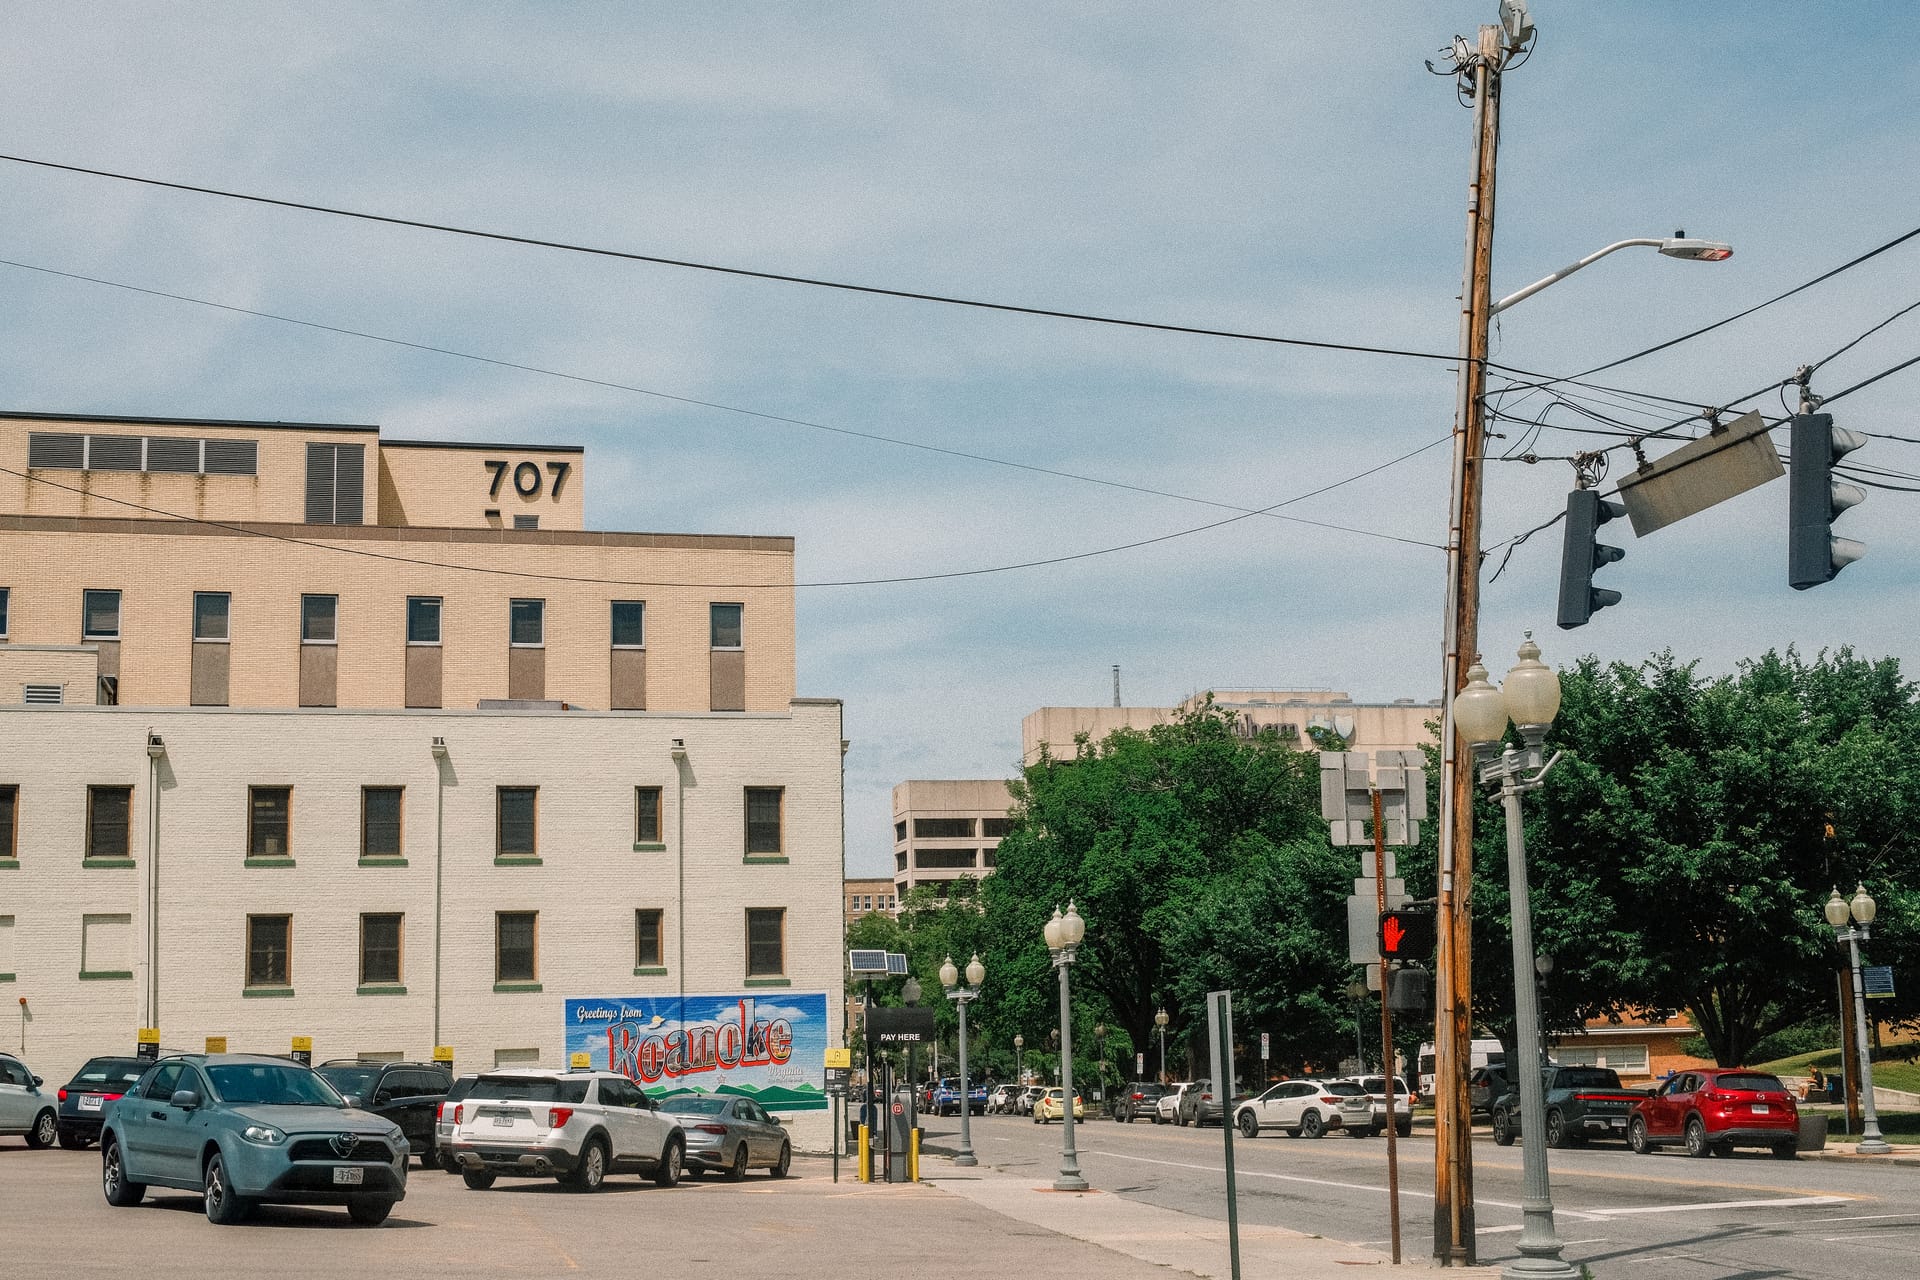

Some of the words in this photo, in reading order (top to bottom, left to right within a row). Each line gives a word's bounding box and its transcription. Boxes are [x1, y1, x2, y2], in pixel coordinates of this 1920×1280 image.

[485, 461, 570, 497] 707
[577, 1005, 618, 1023] Greetings
[620, 1004, 643, 1021] from
[607, 998, 794, 1086] Roanoke
[880, 1033, 897, 1041] PAY
[898, 1033, 921, 1041] HERE
